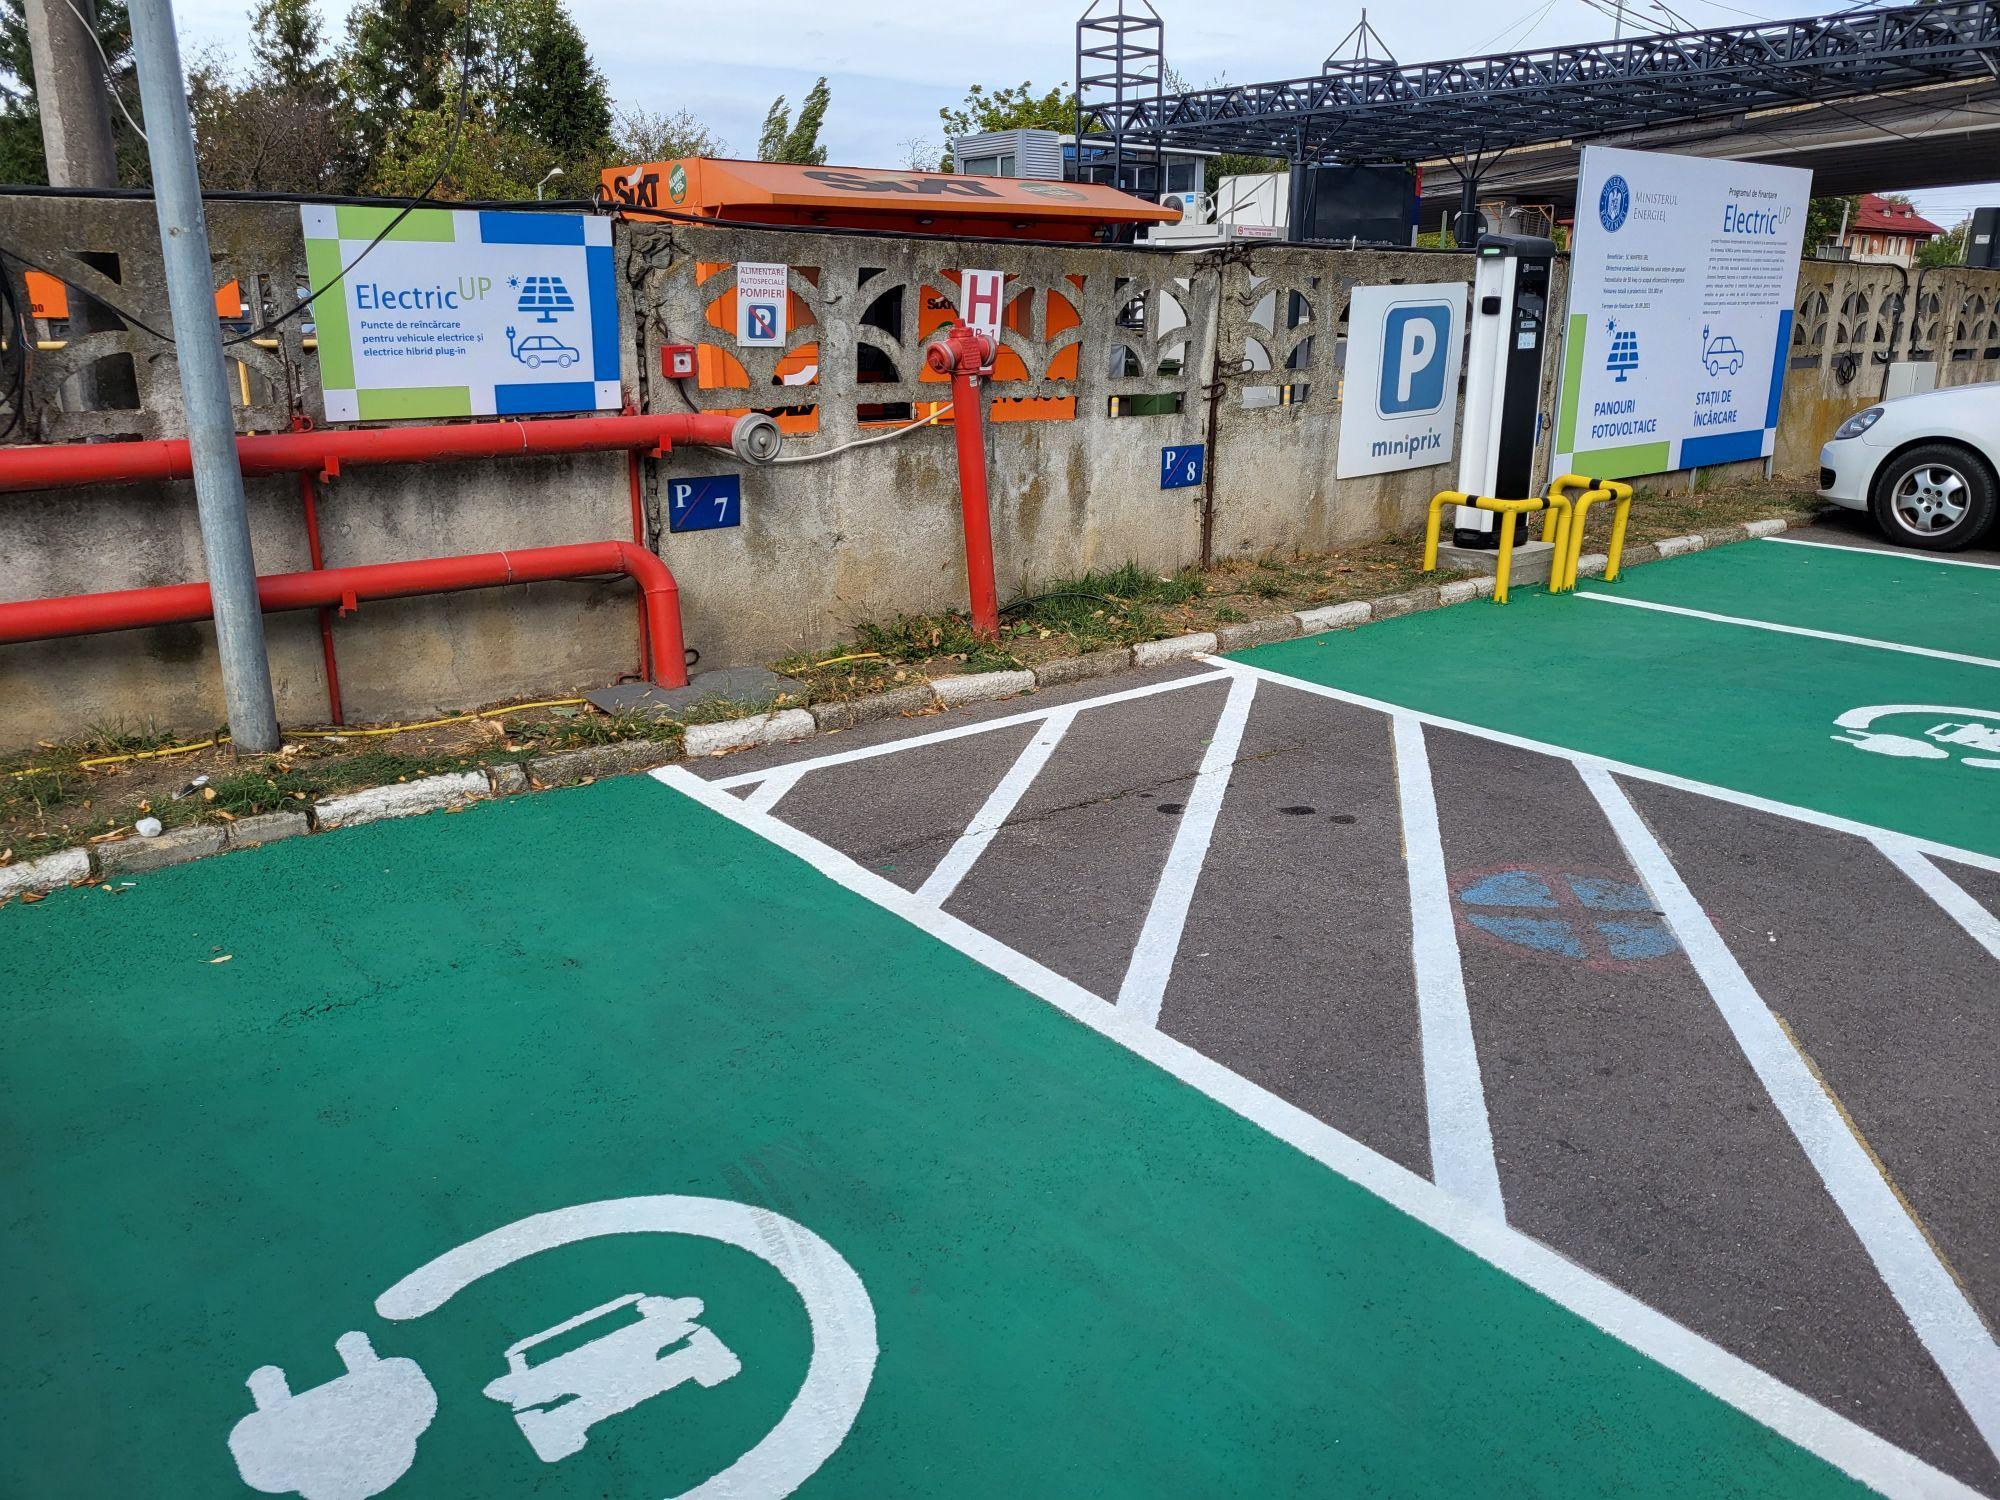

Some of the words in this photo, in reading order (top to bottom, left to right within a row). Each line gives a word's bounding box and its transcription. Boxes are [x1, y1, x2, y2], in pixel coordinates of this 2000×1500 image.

[740, 266, 785, 277] ALIMENTARE
[740, 277, 785, 286] AUTOSPECIALE
[740, 287, 785, 299] POMPIERI
[967, 274, 999, 325] H
[360, 320, 395, 329] Puncte
[396, 320, 408, 329] de
[410, 319, 461, 329] reîncărcare
[362, 335, 394, 344] pentru
[396, 333, 435, 342] vehicule
[437, 332, 475, 342] electrice
[363, 347, 404, 356] electrice
[406, 346, 433, 355] hibrid
[435, 346, 466, 356] plug-in
[1397, 317, 1437, 402] P
[1721, 389, 1732, 403] DE
[1594, 400, 1636, 417] PANOURI
[1693, 409, 1738, 427] ÎNCĂRCARE
[1591, 418, 1657, 439] FOTOVOLTAICE
[1371, 427, 1442, 460] miniprix
[1165, 450, 1177, 470] P
[1186, 461, 1196, 481] 8
[673, 484, 692, 509] P
[713, 496, 729, 522] 7
